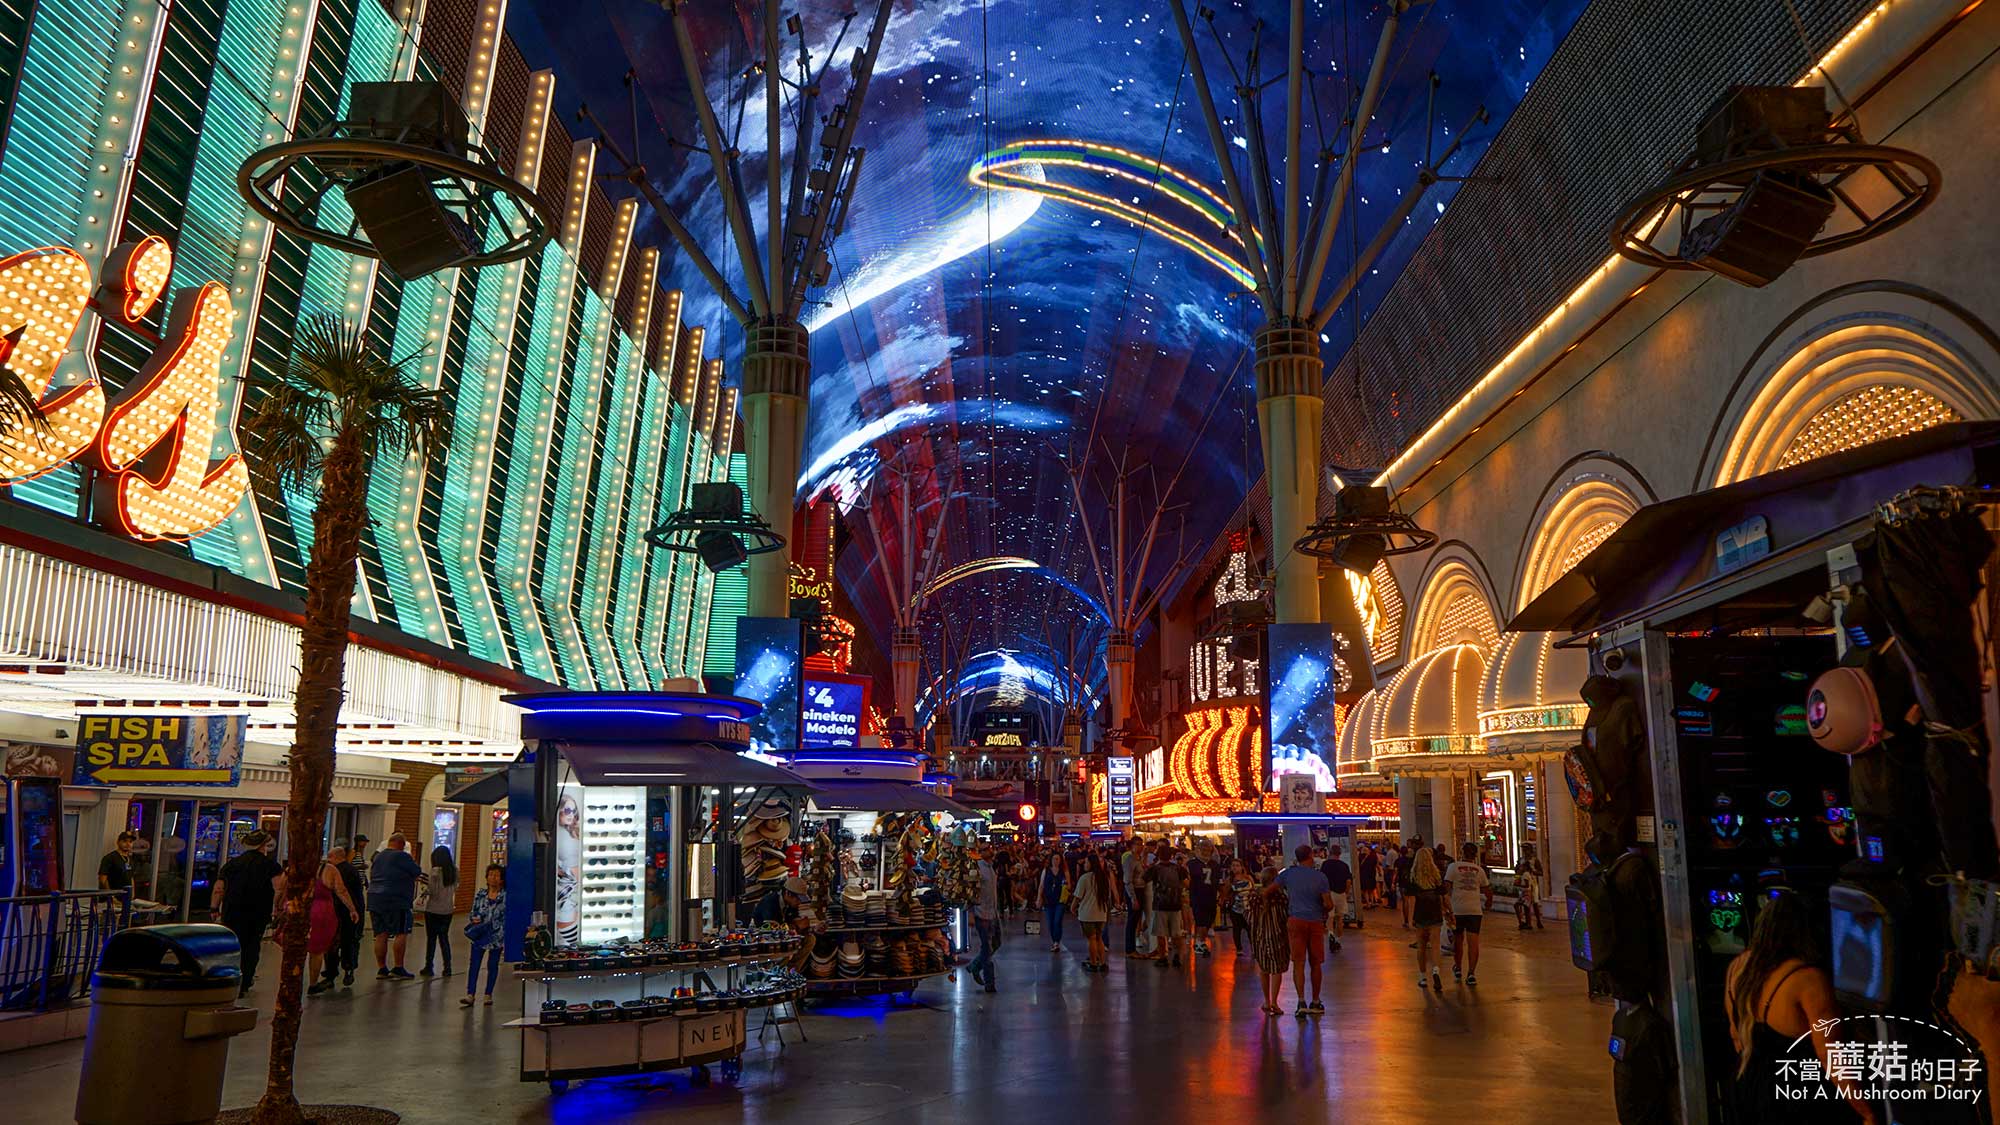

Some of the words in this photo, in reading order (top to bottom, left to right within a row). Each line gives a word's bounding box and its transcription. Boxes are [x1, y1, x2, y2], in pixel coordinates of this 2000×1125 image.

[790, 578, 827, 598] Boyd's
[802, 709, 856, 723] eineken
[84, 717, 180, 740] FISH
[806, 722, 857, 735] Modelo
[87, 742, 170, 766] SPA
[1201, 867, 1212, 885] 7
